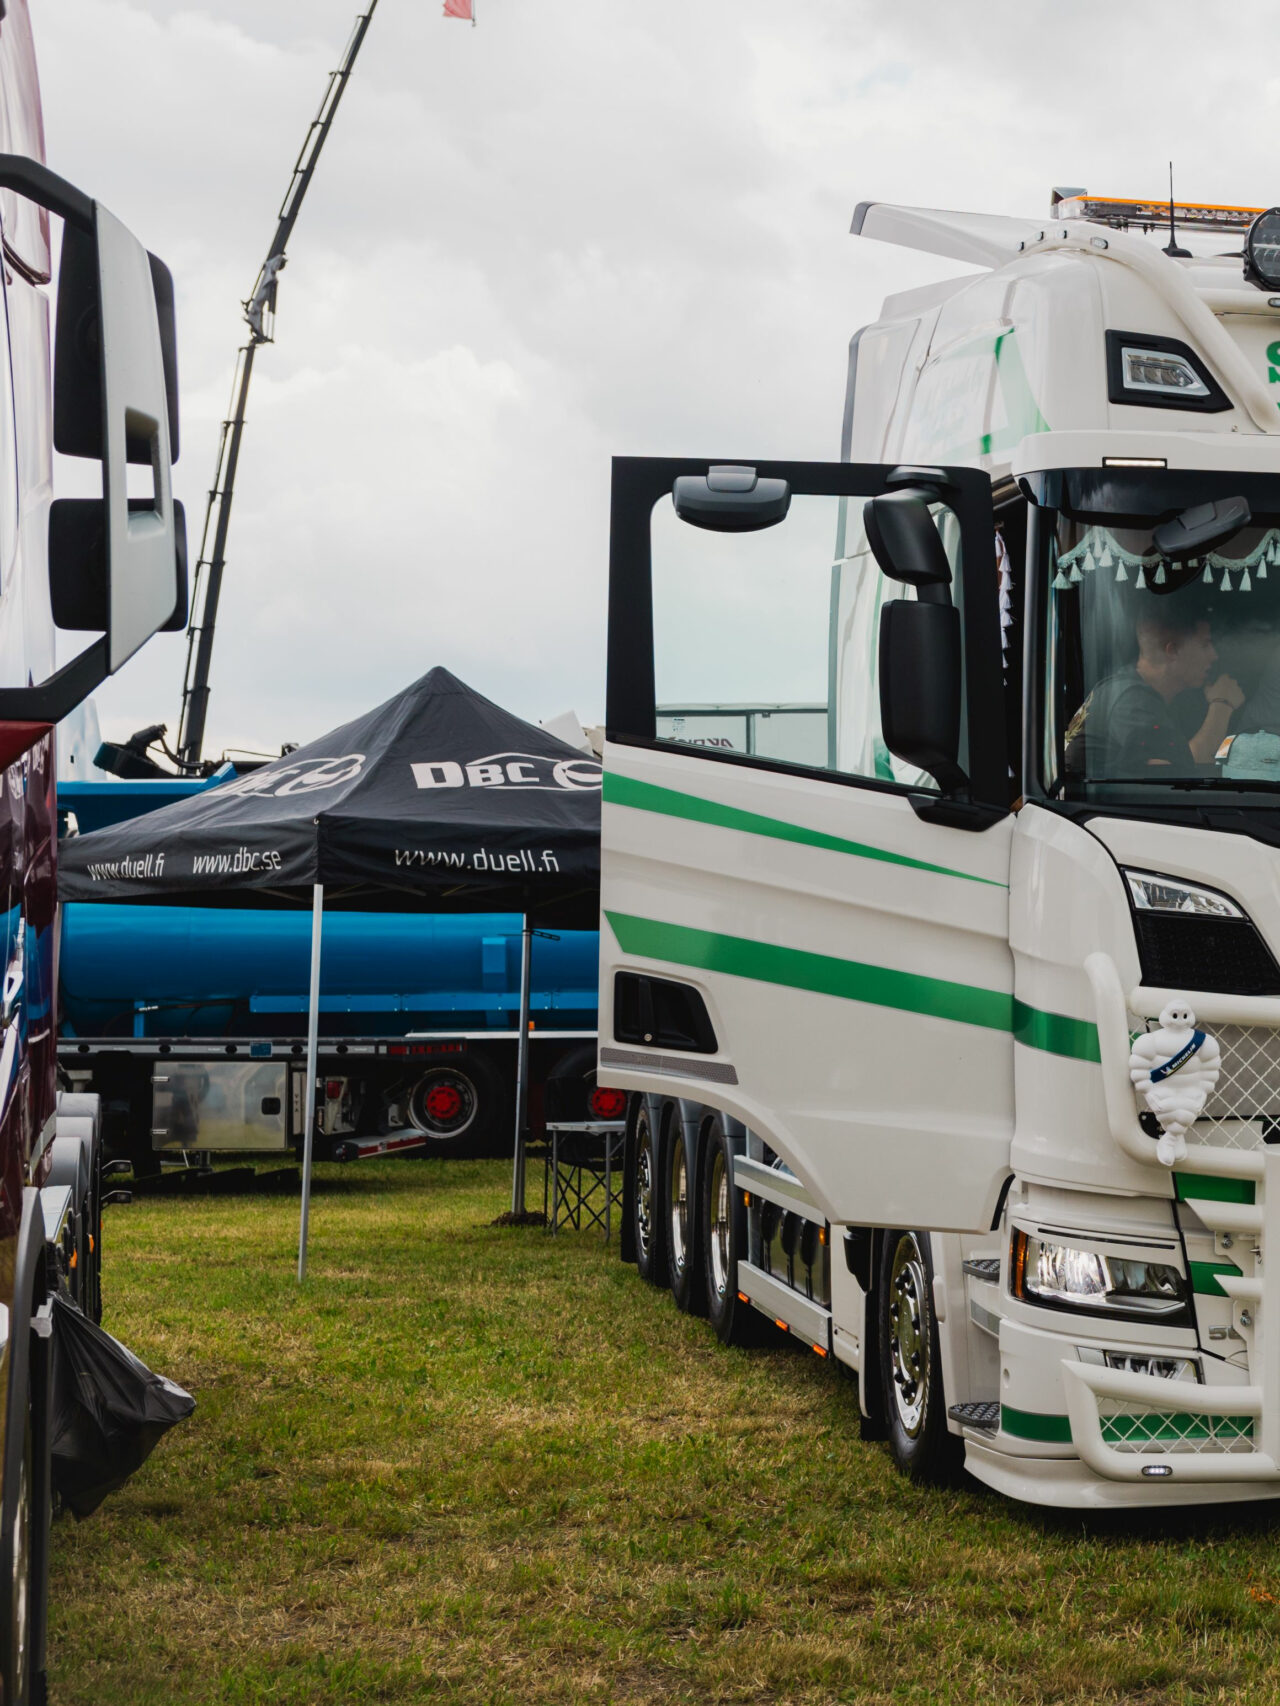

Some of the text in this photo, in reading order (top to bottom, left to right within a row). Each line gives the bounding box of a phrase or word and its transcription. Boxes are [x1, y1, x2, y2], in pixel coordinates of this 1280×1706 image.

[410, 760, 540, 790] DBC
[87, 852, 165, 881] www.duell.fi
[192, 847, 282, 874] www.dbc.se
[394, 847, 561, 873] www.duell.fi
